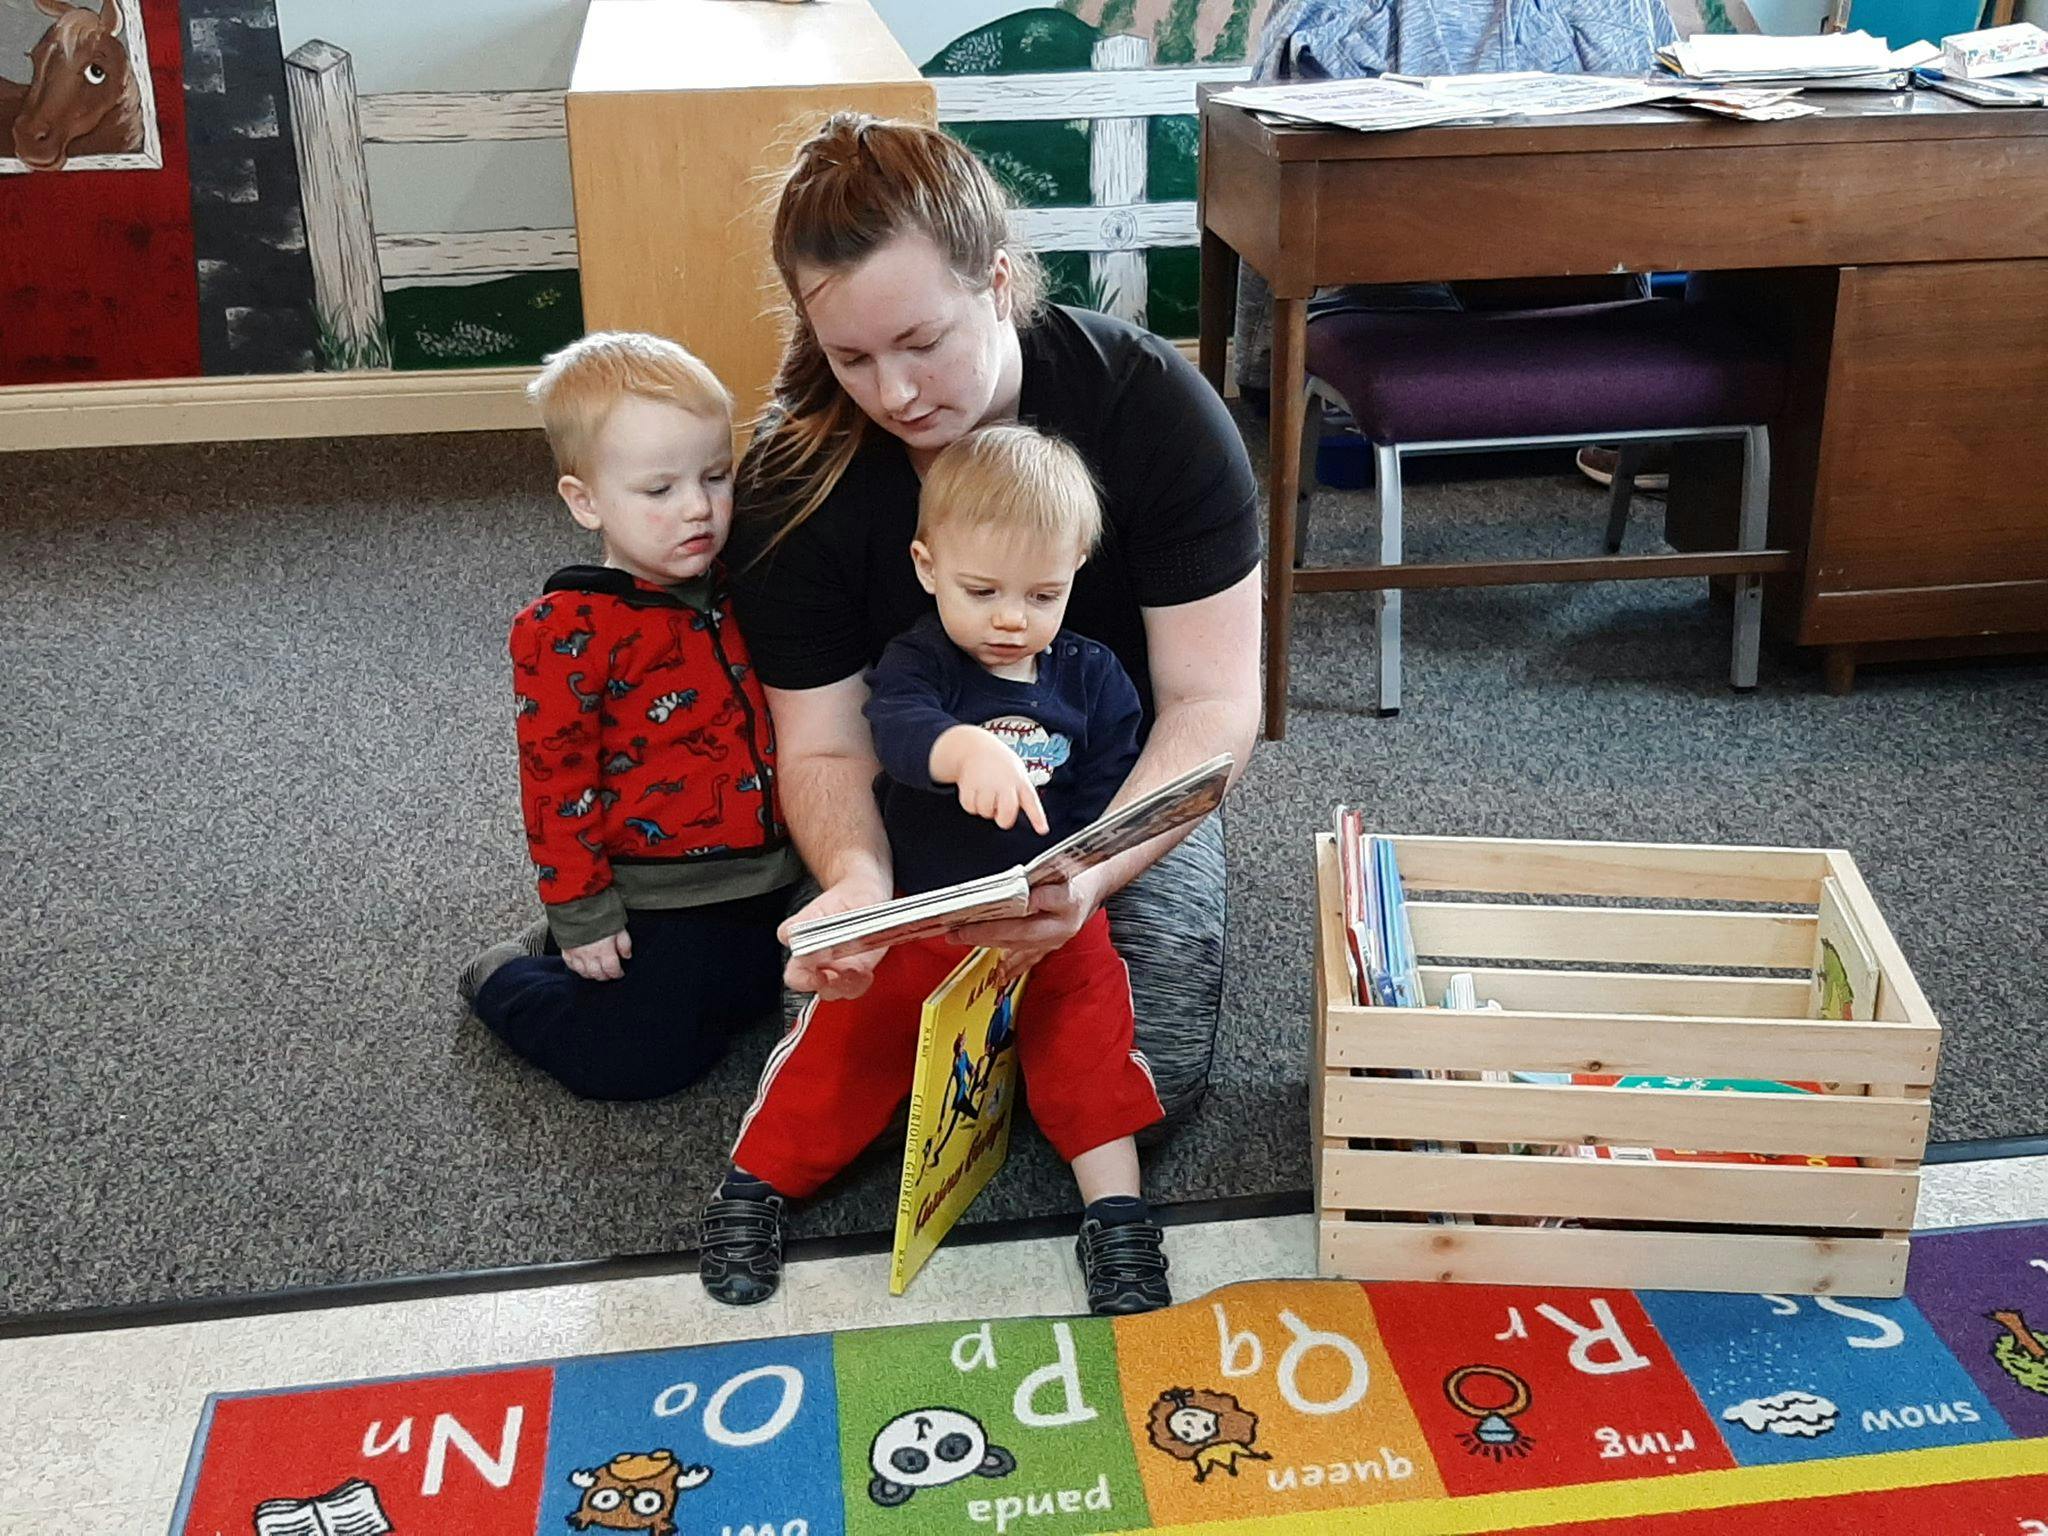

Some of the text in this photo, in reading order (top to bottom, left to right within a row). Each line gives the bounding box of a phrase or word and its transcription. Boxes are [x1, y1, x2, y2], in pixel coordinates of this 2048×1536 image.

[901, 1094, 923, 1216] CURIOUS GEORGE
[1862, 1401, 1980, 1431] snow
[1595, 1427, 1696, 1463] ring
[1267, 1448, 1413, 1492] queen
[967, 1473, 1112, 1534] panda
